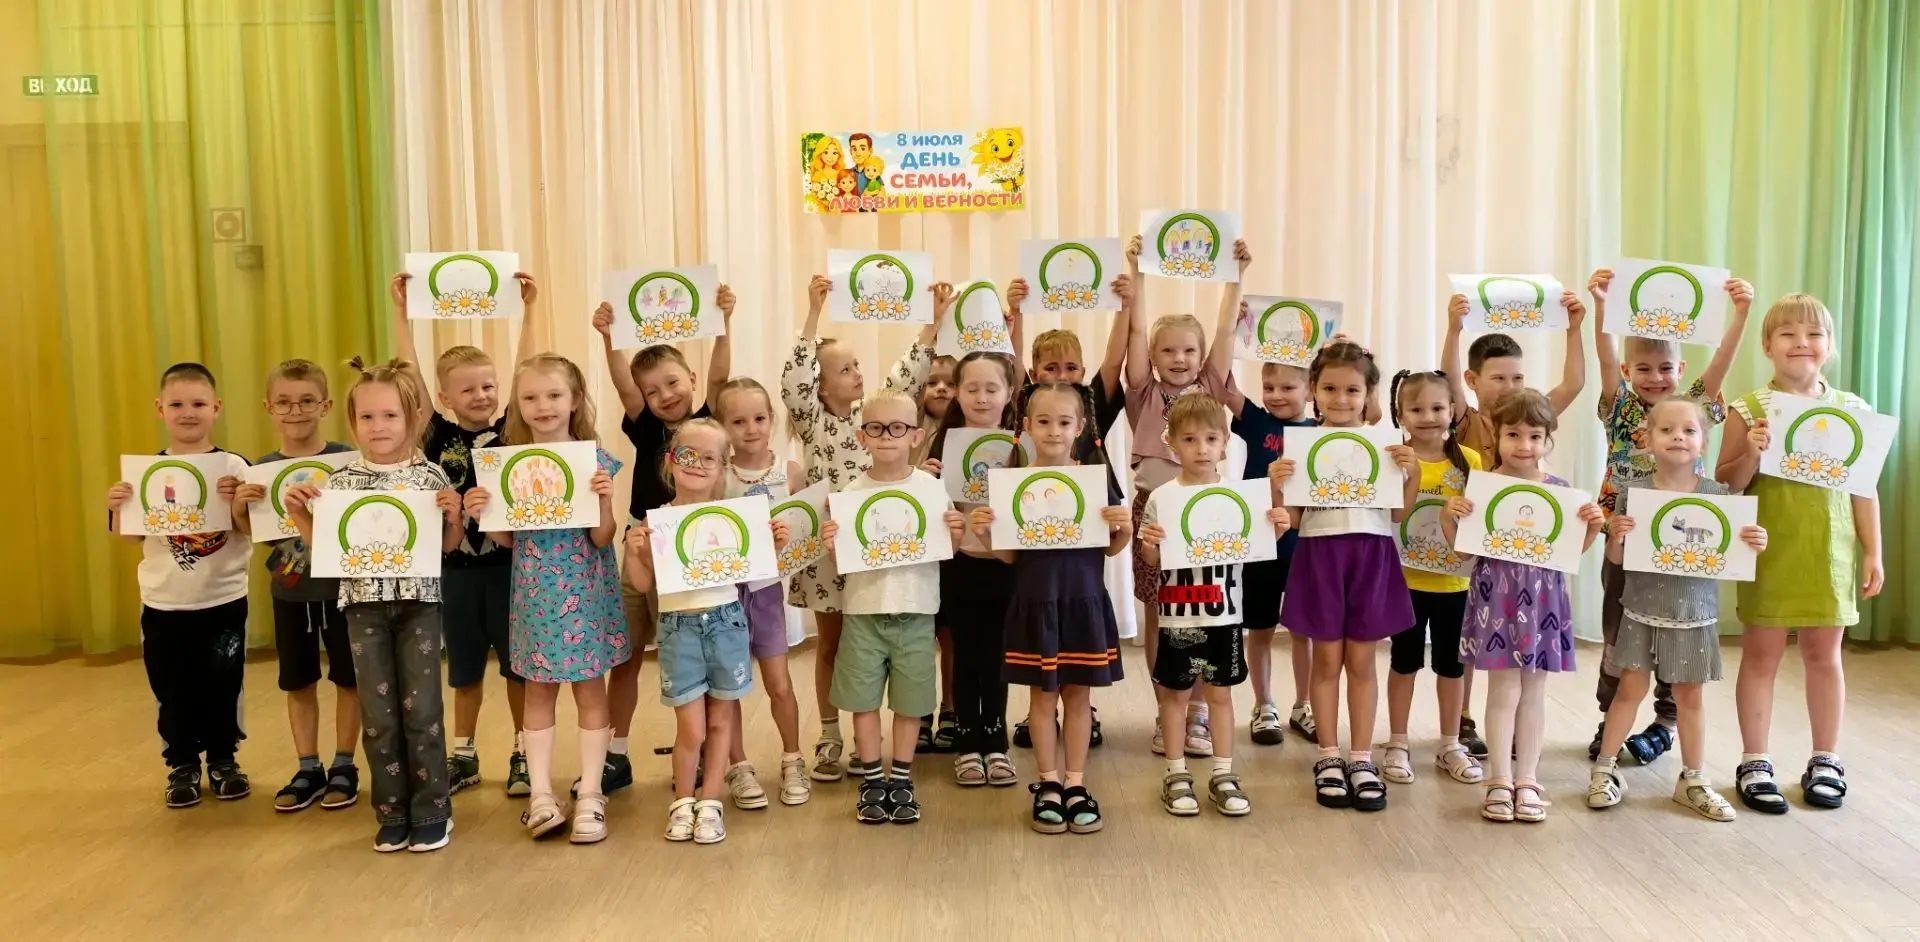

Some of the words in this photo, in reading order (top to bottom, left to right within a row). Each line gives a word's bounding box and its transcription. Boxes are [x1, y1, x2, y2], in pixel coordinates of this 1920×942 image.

[897, 133, 907, 146] 8
[900, 151, 961, 170] ДЕНЬ
[890, 172, 973, 190] СЕМЬИ,
[829, 195, 900, 210] ЛЮБВИ
[905, 195, 918, 208] И
[922, 192, 1023, 208] ВЕРНОСТИ
